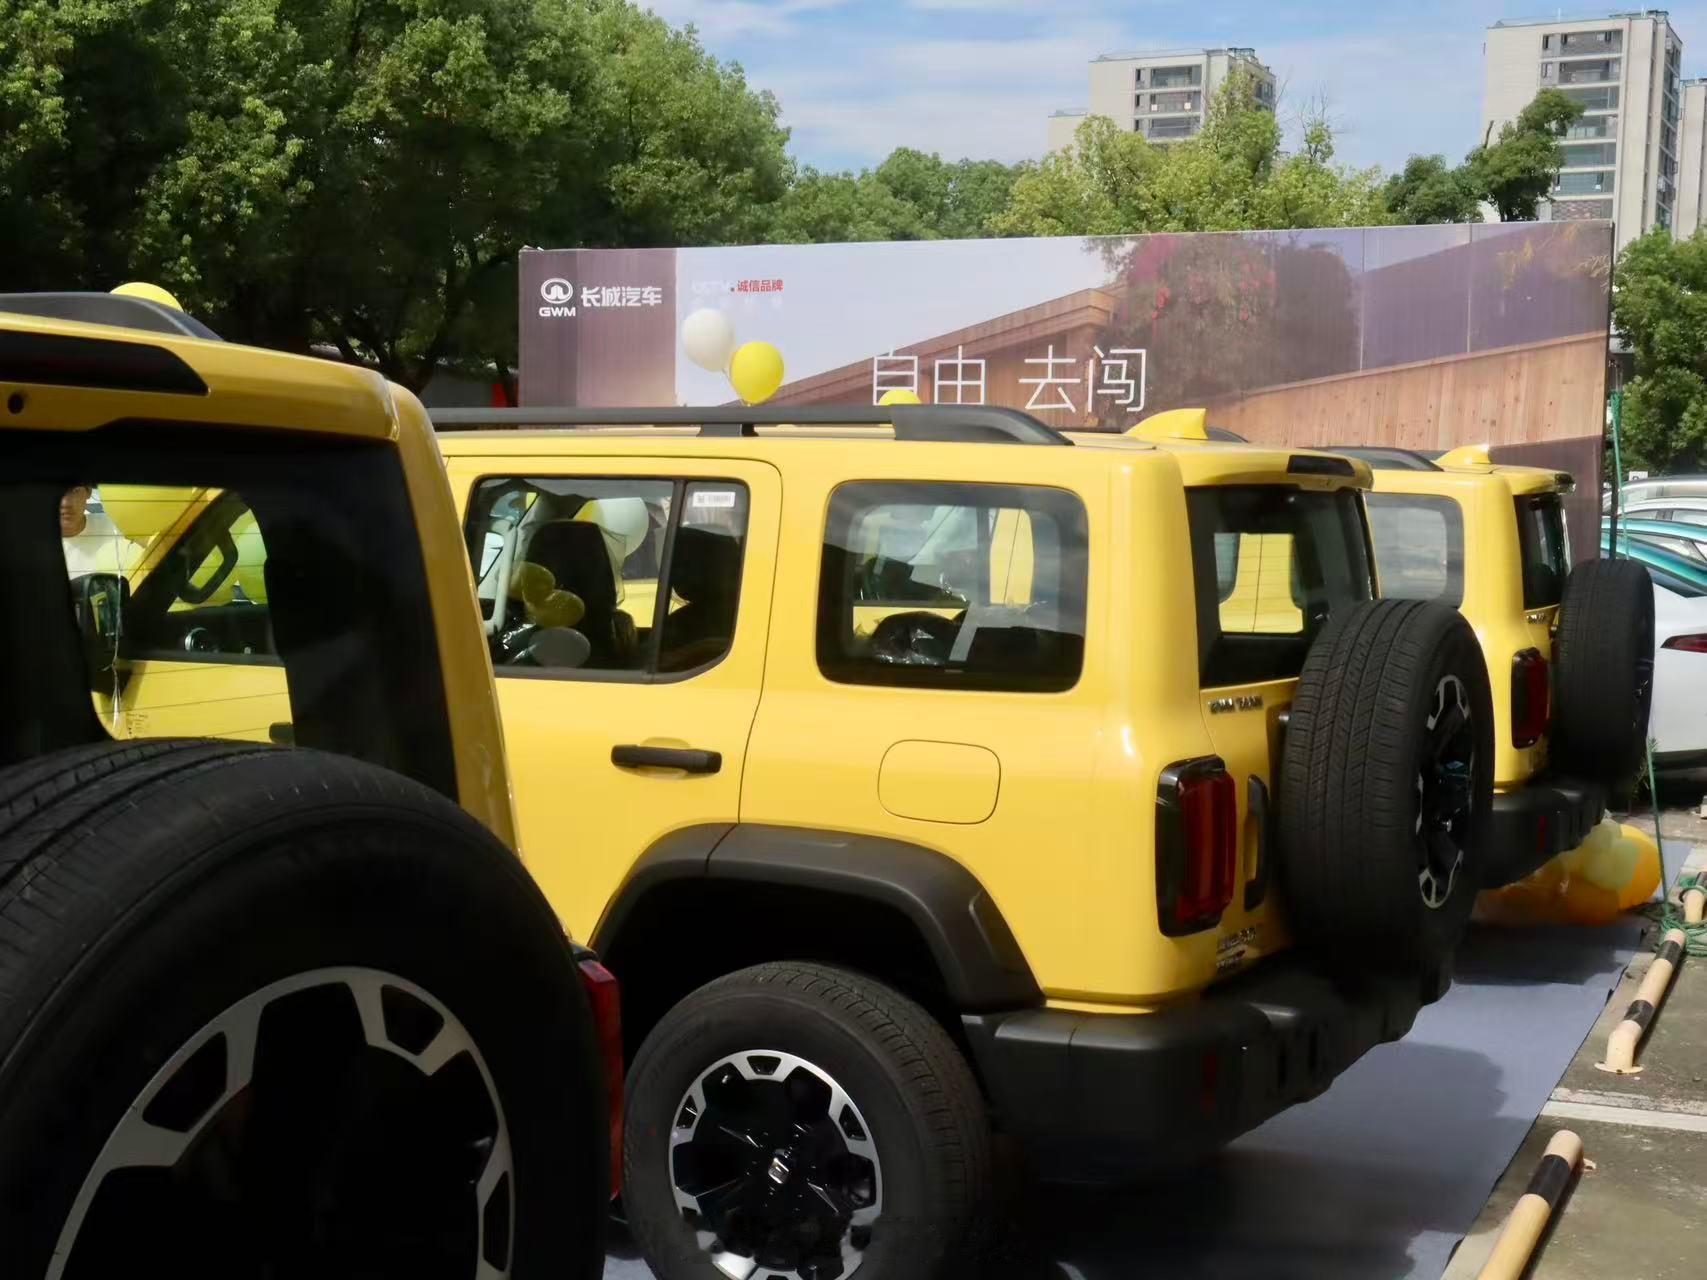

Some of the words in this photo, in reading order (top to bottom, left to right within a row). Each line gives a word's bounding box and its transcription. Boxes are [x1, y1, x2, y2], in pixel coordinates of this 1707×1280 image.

[581, 286, 662, 307] 长城汽车
[539, 306, 577, 317] GWM
